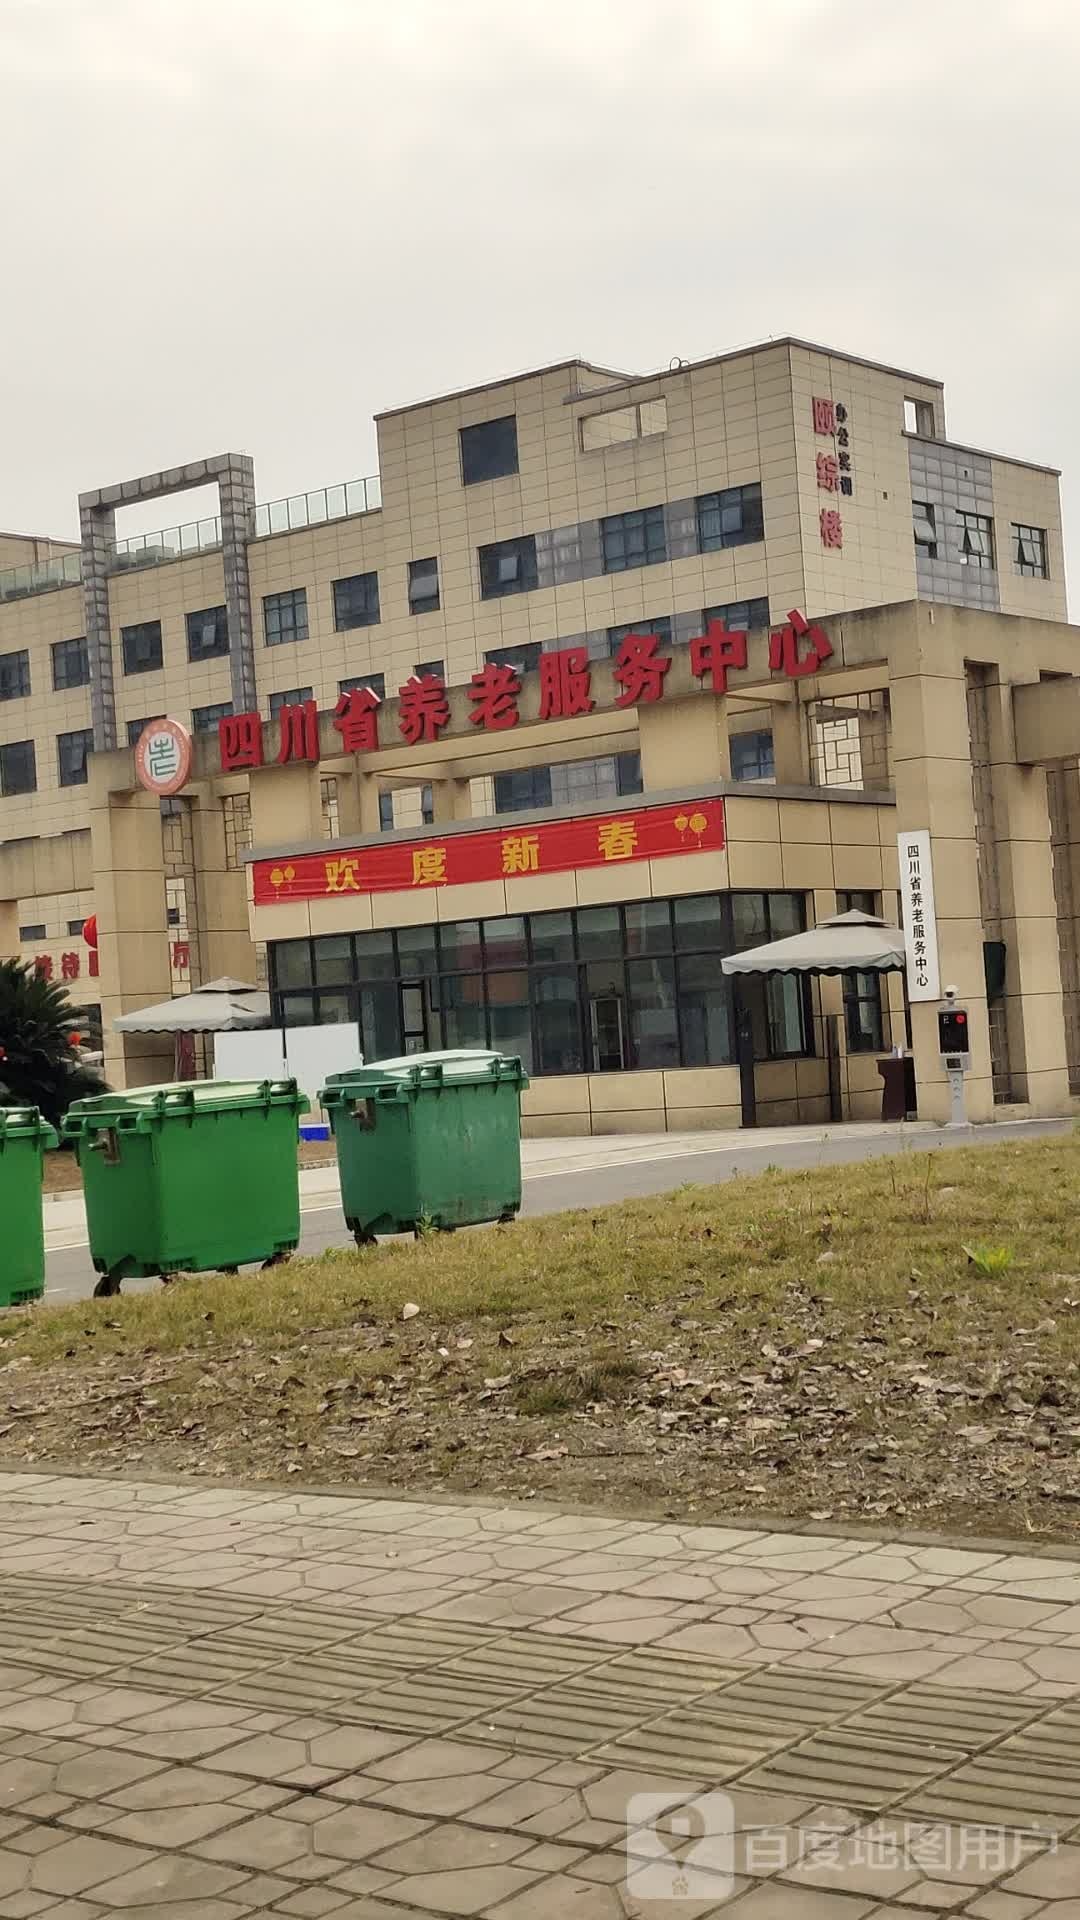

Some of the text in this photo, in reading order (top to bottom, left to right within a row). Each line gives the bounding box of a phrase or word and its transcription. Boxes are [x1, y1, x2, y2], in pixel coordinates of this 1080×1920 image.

[218, 609, 833, 772] 四川省养老服务中心
[325, 820, 638, 893] 欢度新春
[907, 845, 928, 987] 四川省养老服务中心
